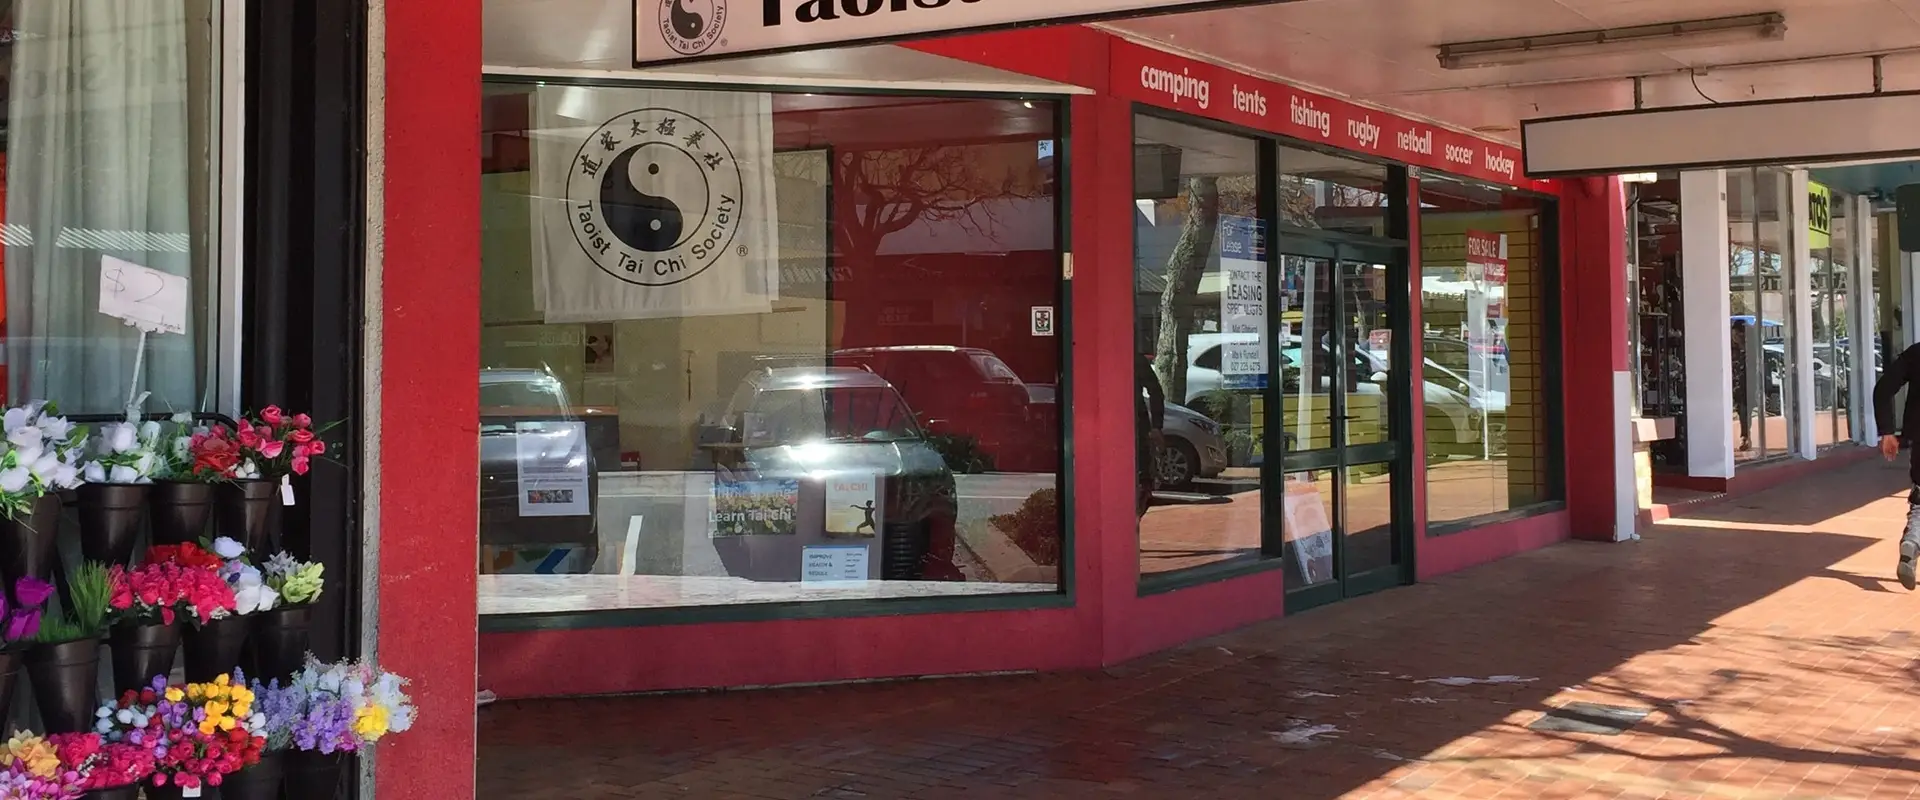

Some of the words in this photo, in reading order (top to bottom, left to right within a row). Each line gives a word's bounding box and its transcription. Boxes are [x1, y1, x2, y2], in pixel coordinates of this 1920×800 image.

[663, 18, 678, 43] Taoist
[679, 40, 689, 50] Tai
[692, 39, 706, 49] Chi
[706, 5, 724, 40] Society
[1140, 65, 1209, 109] camping
[1232, 83, 1267, 117] tents
[1290, 94, 1330, 138] fishing
[1347, 115, 1380, 149] rugby
[1397, 127, 1433, 155] netball
[1445, 143, 1474, 165] soccer
[1485, 147, 1515, 181] hockey
[577, 200, 613, 256] Taoist
[617, 251, 644, 275] Tai
[653, 255, 687, 276] Chi
[691, 194, 736, 260] Society
[1222, 220, 1233, 237] For
[1222, 238, 1243, 254] Lease
[1468, 236, 1481, 256] FOR
[1481, 239, 1497, 258] SALE
[1251, 270, 1262, 282] THE
[1226, 283, 1263, 302] LEASING
[1226, 302, 1264, 316] SPEALISTS
[708, 511, 746, 522] Learn
[747, 508, 768, 521] Tai
[772, 507, 792, 520] Chi
